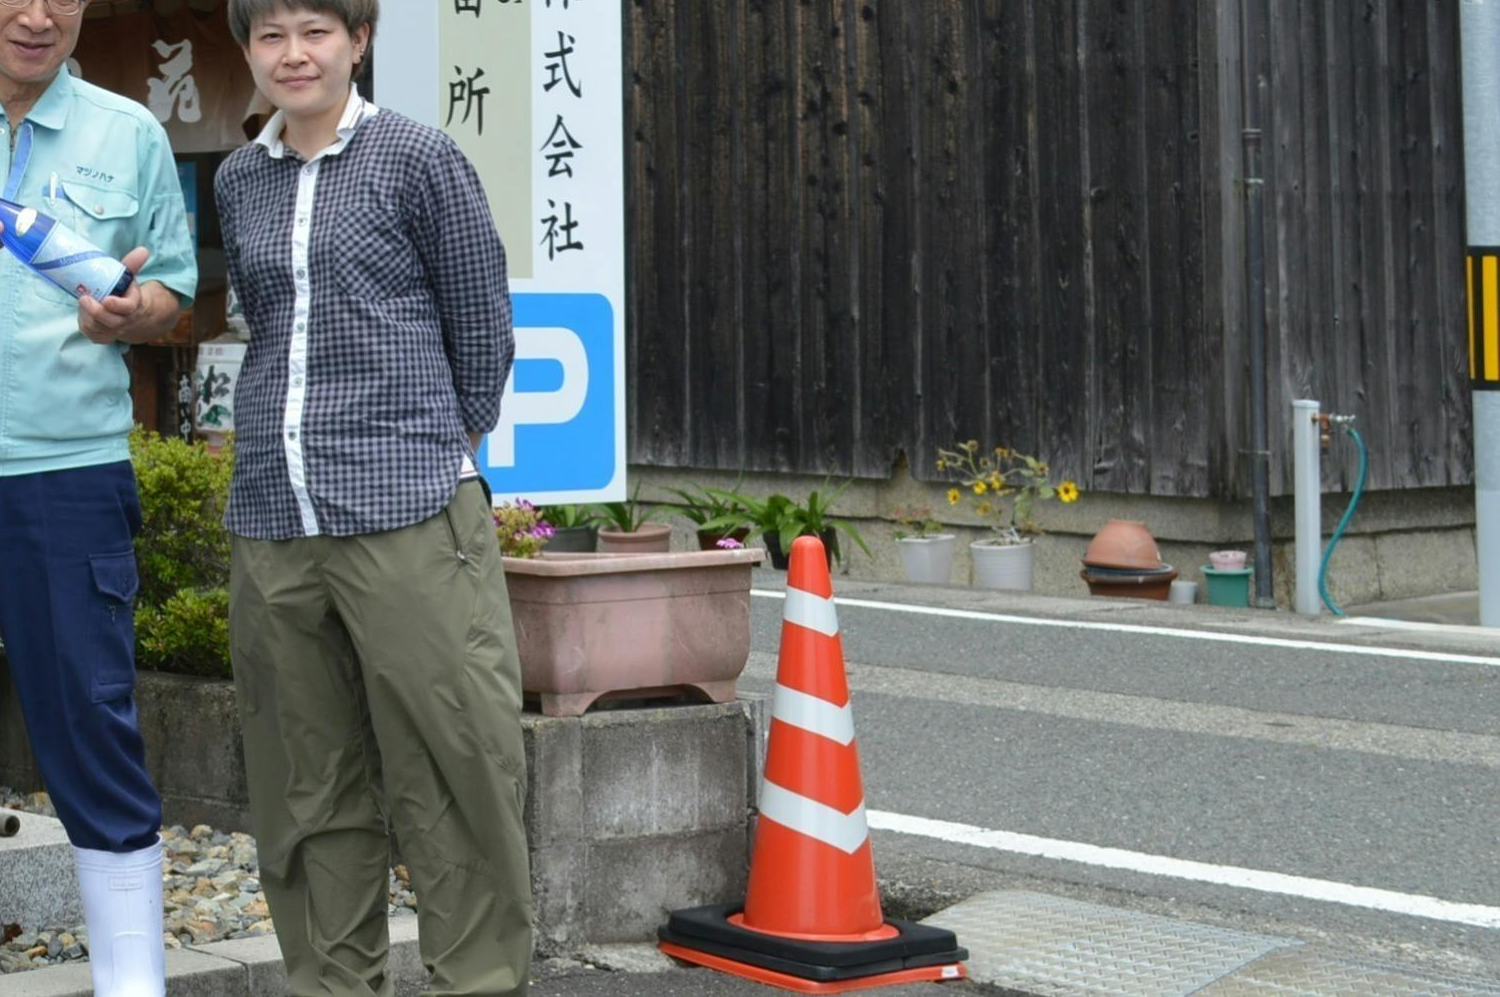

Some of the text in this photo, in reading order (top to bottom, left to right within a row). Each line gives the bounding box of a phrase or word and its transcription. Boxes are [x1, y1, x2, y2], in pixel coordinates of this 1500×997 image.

[76, 165, 115, 183] マツノハナ
[487, 326, 589, 468] P
